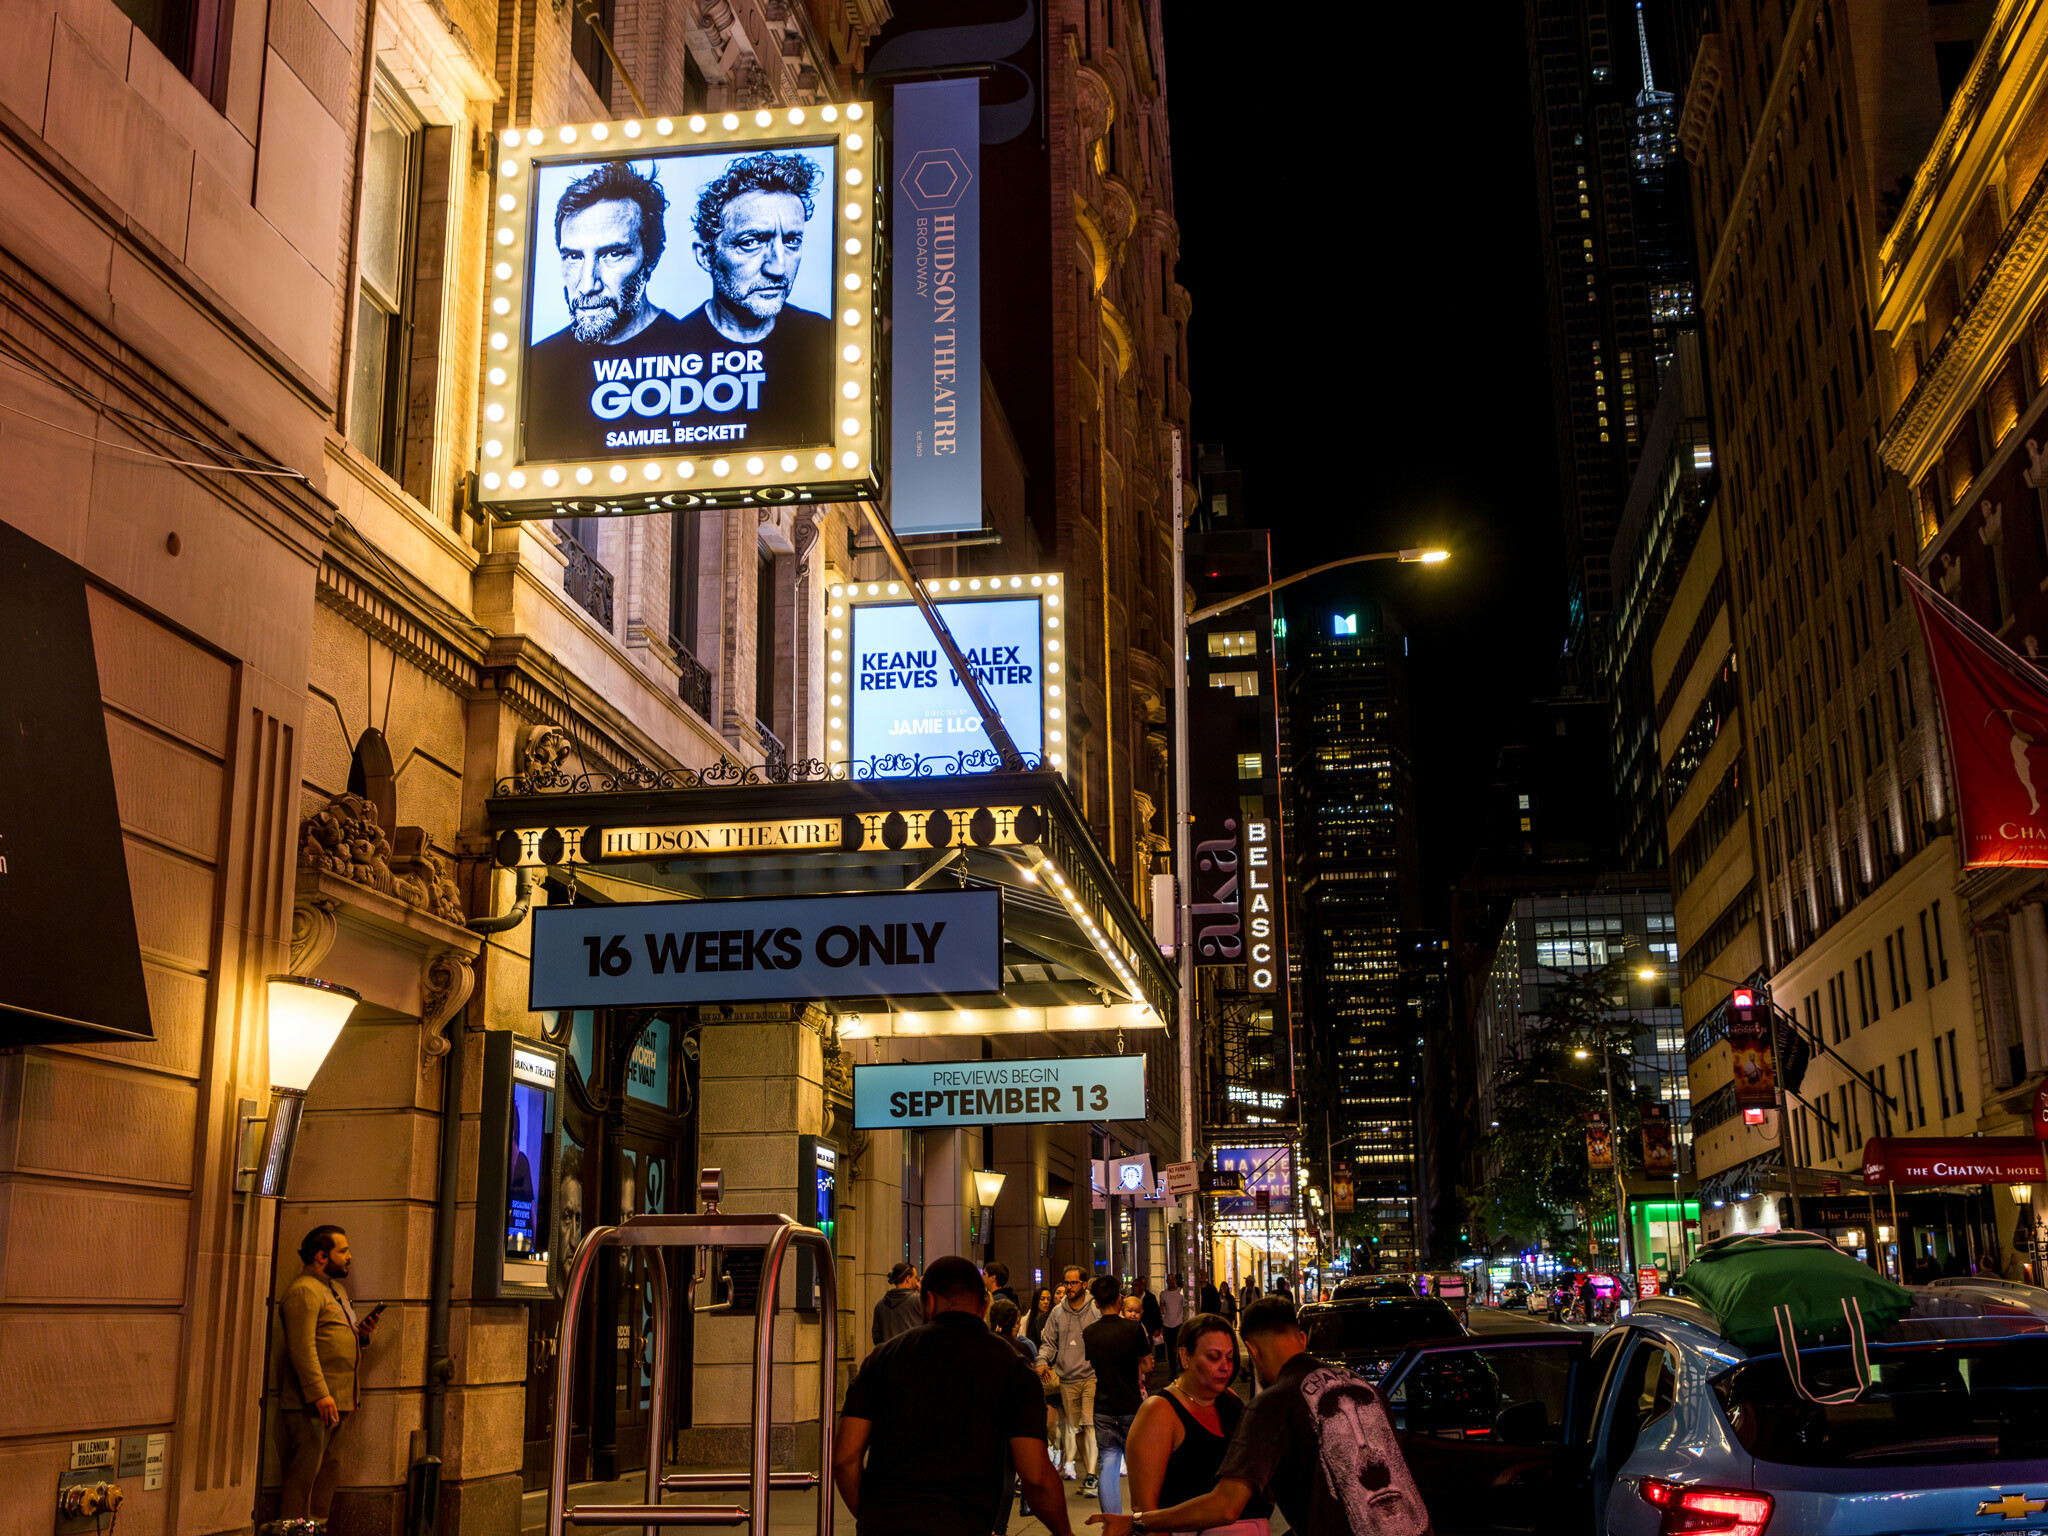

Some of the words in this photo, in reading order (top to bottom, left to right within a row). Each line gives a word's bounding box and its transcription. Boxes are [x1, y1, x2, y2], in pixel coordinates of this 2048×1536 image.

[916, 217, 928, 298] BROADWAY
[933, 213, 956, 323] HUDSON
[593, 353, 704, 382] WAITING
[711, 350, 763, 374] FOR
[591, 372, 766, 421] GODOT
[934, 328, 956, 456] THEATRE
[606, 428, 671, 448] SAMUEL
[674, 423, 747, 443] BECKETT
[862, 650, 937, 671] KEANU
[966, 646, 1021, 666] ALEX
[860, 669, 938, 691] REEVES
[925, 709, 957, 717] DIRECTED
[888, 717, 942, 736] JAMIE
[947, 716, 985, 733] LLO
[607, 829, 711, 854] HUDSON
[719, 821, 842, 849] THEATRE
[1248, 822, 1272, 989] BELASCO
[583, 933, 632, 977] 16
[645, 926, 802, 975] WEEKS
[815, 921, 947, 969] ONLY
[631, 1045, 657, 1070] WORTH
[638, 1064, 656, 1088] WAIT
[933, 1069, 1008, 1086] PREVIEWS
[1012, 1068, 1059, 1084] BEGIN
[890, 1086, 1061, 1118] SEPTEMBER
[1072, 1084, 1109, 1112] 13
[1224, 1158, 1290, 1171] MAYBE
[1906, 1167, 1929, 1176] THE
[1933, 1162, 2003, 1176] CHATWAL
[2007, 1167, 2042, 1176] HOTEL
[1818, 1209, 1841, 1220] The
[1844, 1209, 1874, 1222] Long
[78, 1440, 110, 1454] MILLENNIUM
[78, 1453, 108, 1466] BROADWAY
